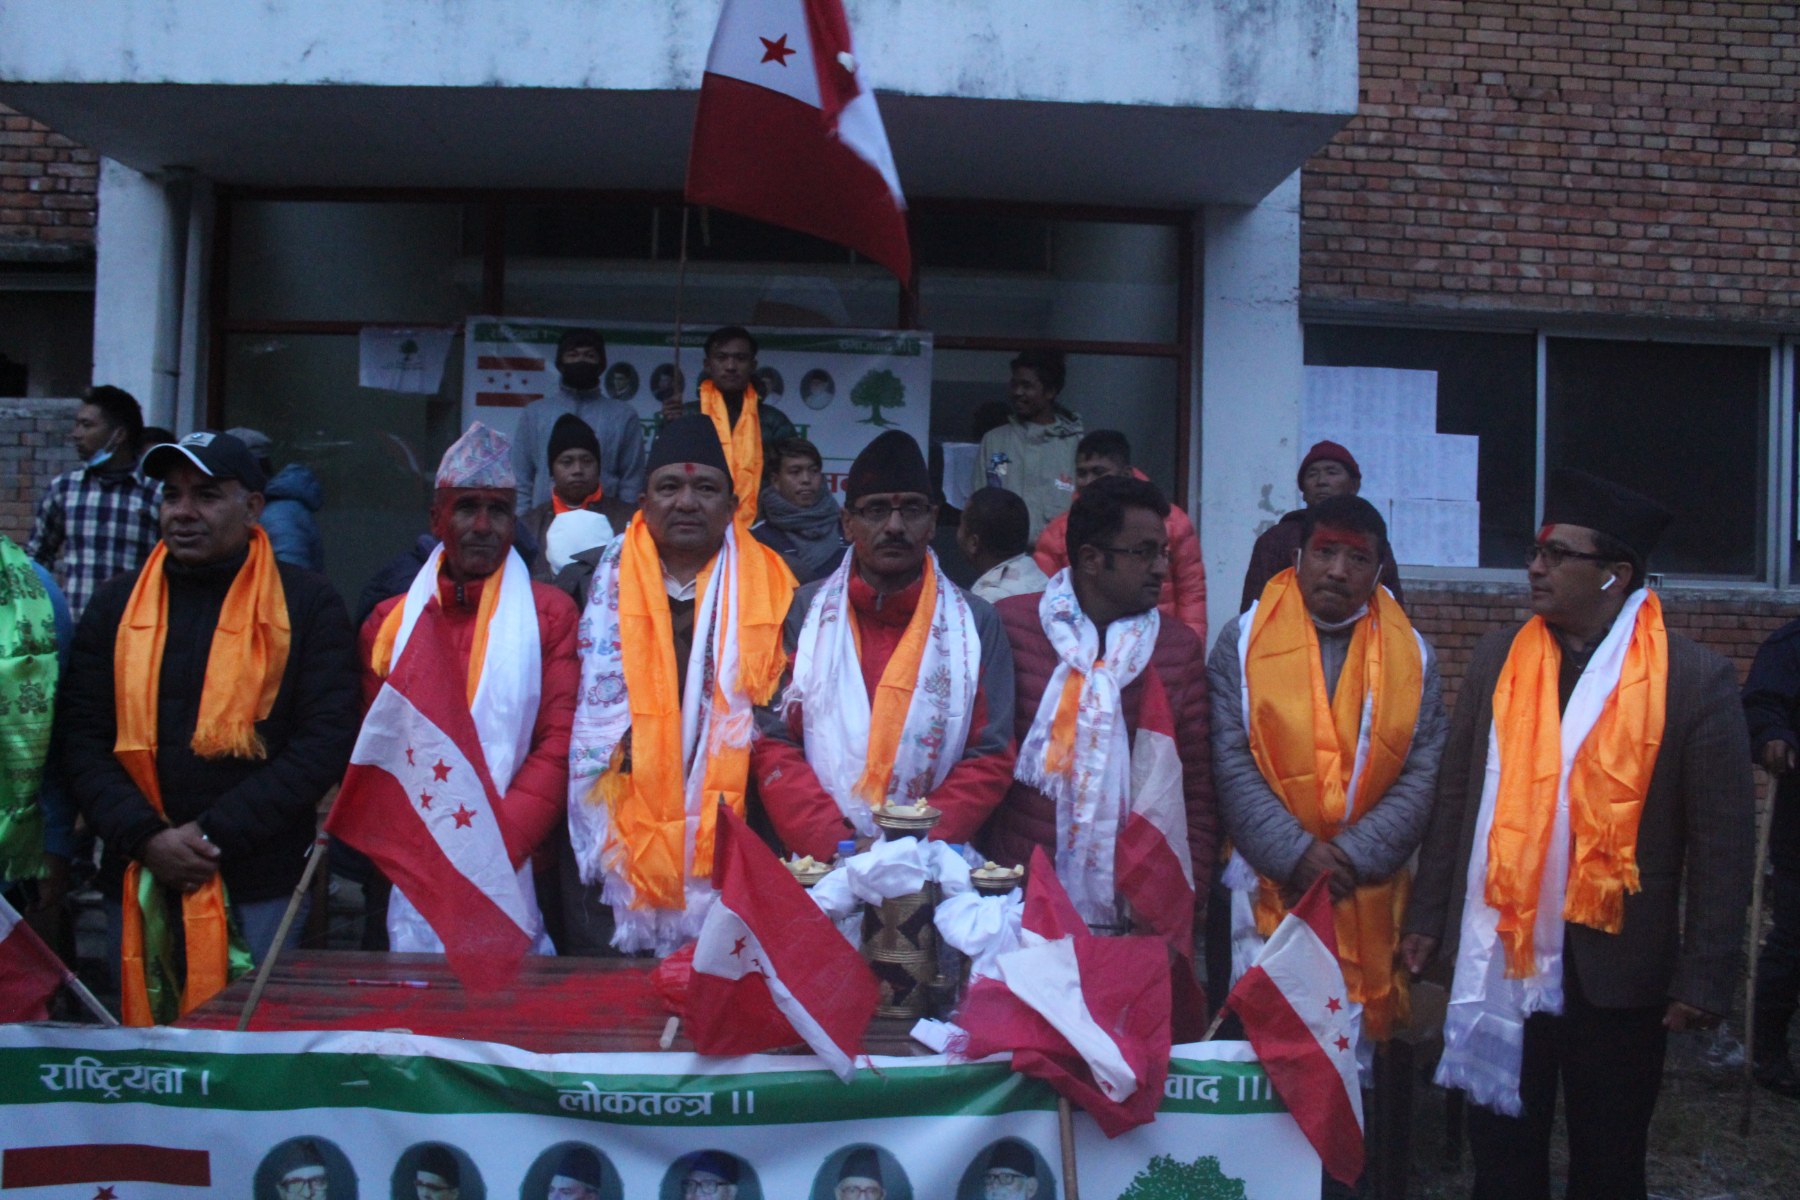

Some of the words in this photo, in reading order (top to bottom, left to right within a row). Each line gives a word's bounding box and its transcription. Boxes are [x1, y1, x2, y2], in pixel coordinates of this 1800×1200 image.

[39, 1056, 187, 1099] राष्ट्रियता
[557, 1080, 715, 1117] लोकतन्त्र
[1163, 1073, 1223, 1104] वाद
